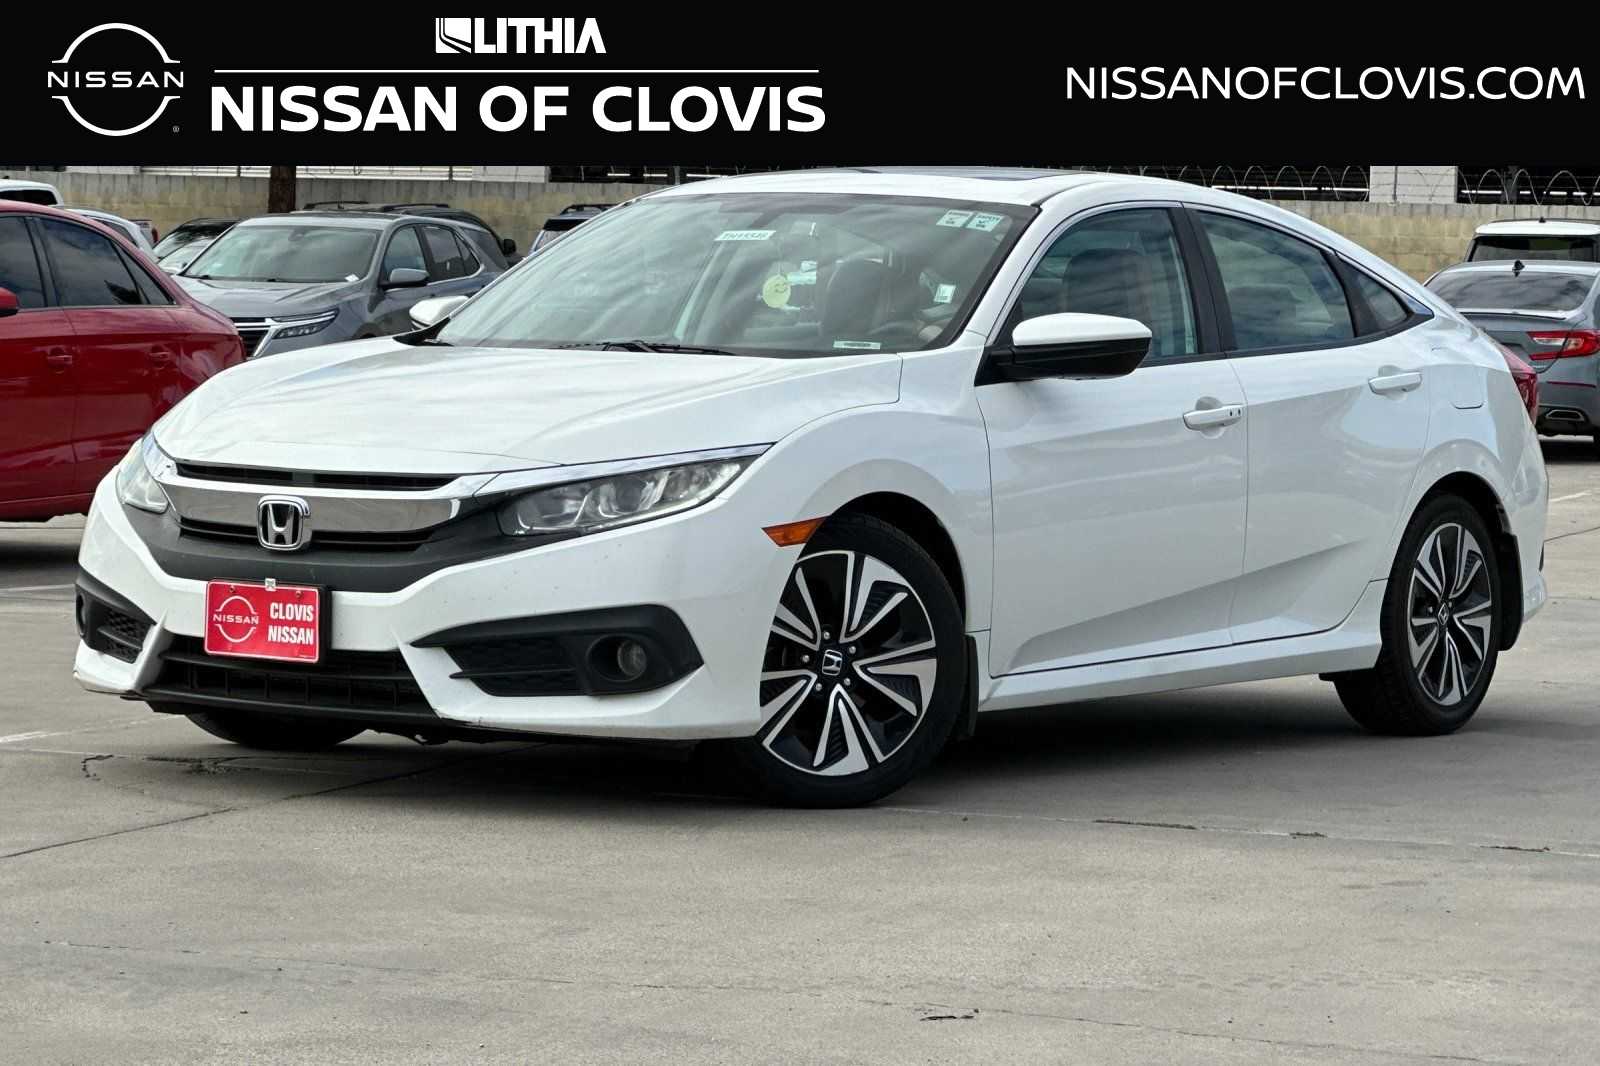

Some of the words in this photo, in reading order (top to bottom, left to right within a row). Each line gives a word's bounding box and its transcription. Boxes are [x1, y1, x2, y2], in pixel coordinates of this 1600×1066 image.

[213, 613, 259, 625] NISSAN
[269, 602, 314, 622] CLOVIS
[267, 625, 314, 645] NISSAN
